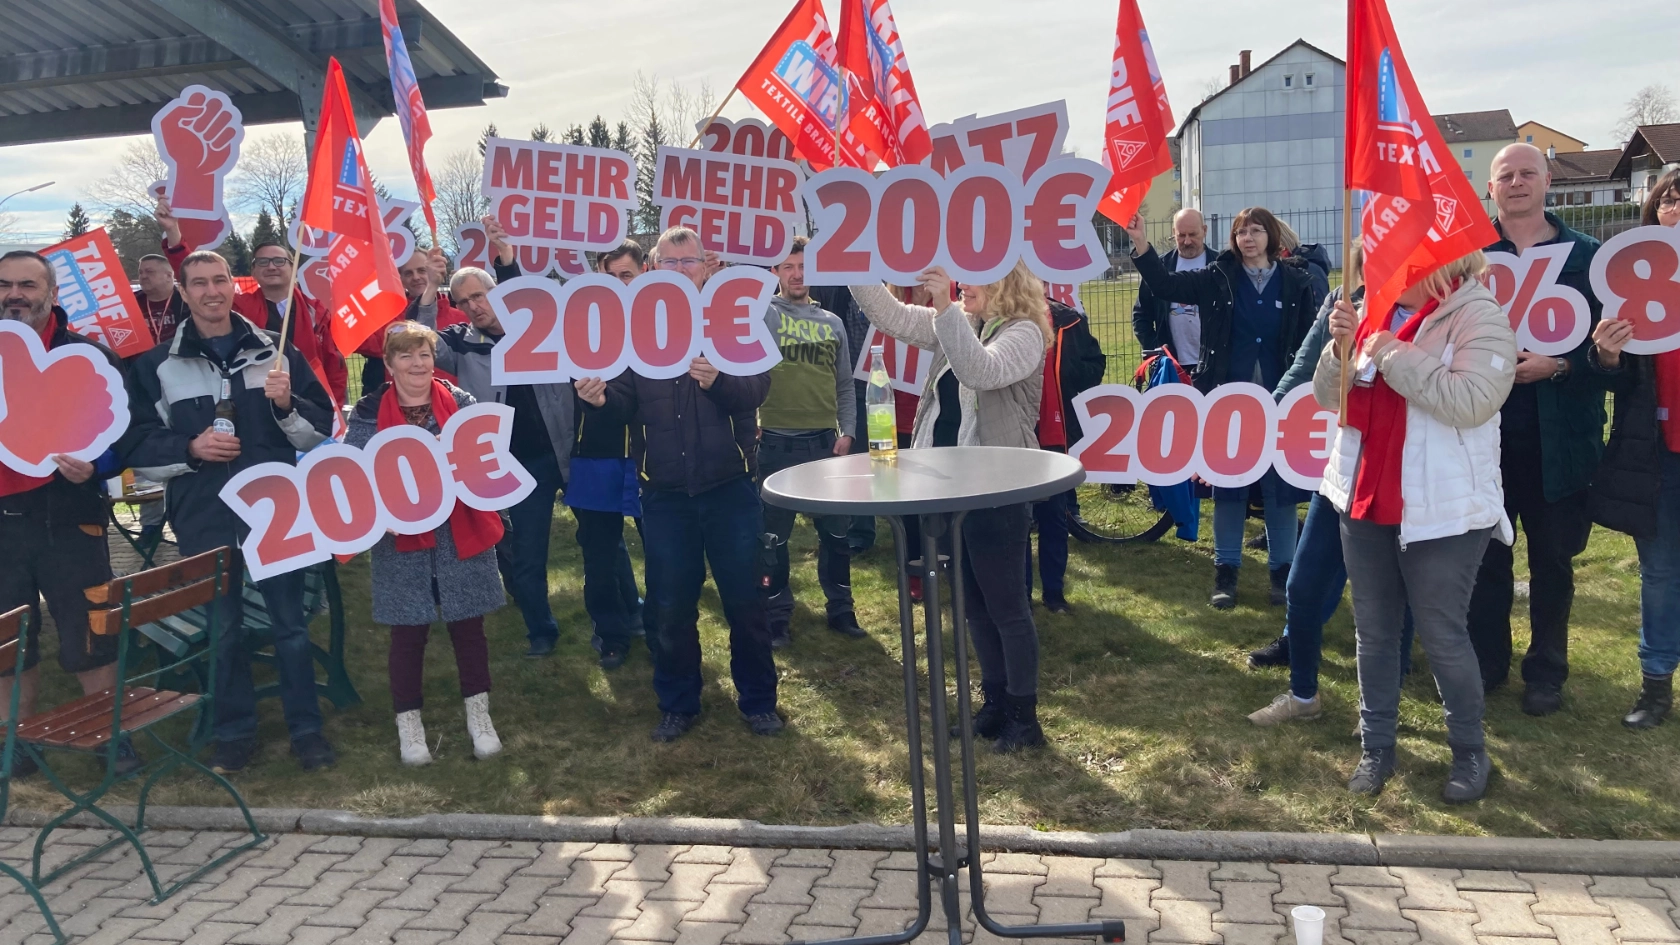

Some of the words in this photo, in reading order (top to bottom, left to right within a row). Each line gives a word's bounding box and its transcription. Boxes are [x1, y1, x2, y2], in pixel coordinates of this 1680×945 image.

[761, 79, 806, 125] TEXTILE
[491, 146, 629, 200] MEHR
[661, 155, 797, 213] MEHR
[498, 194, 619, 243] GELD
[668, 205, 785, 258] GELD
[816, 173, 1094, 273] 200€
[73, 240, 129, 321] TARIF
[504, 277, 768, 373] 200€
[777, 313, 823, 341] JACK
[780, 337, 837, 367] JONES
[1079, 393, 1338, 478] 200€
[236, 414, 522, 566] 200€
